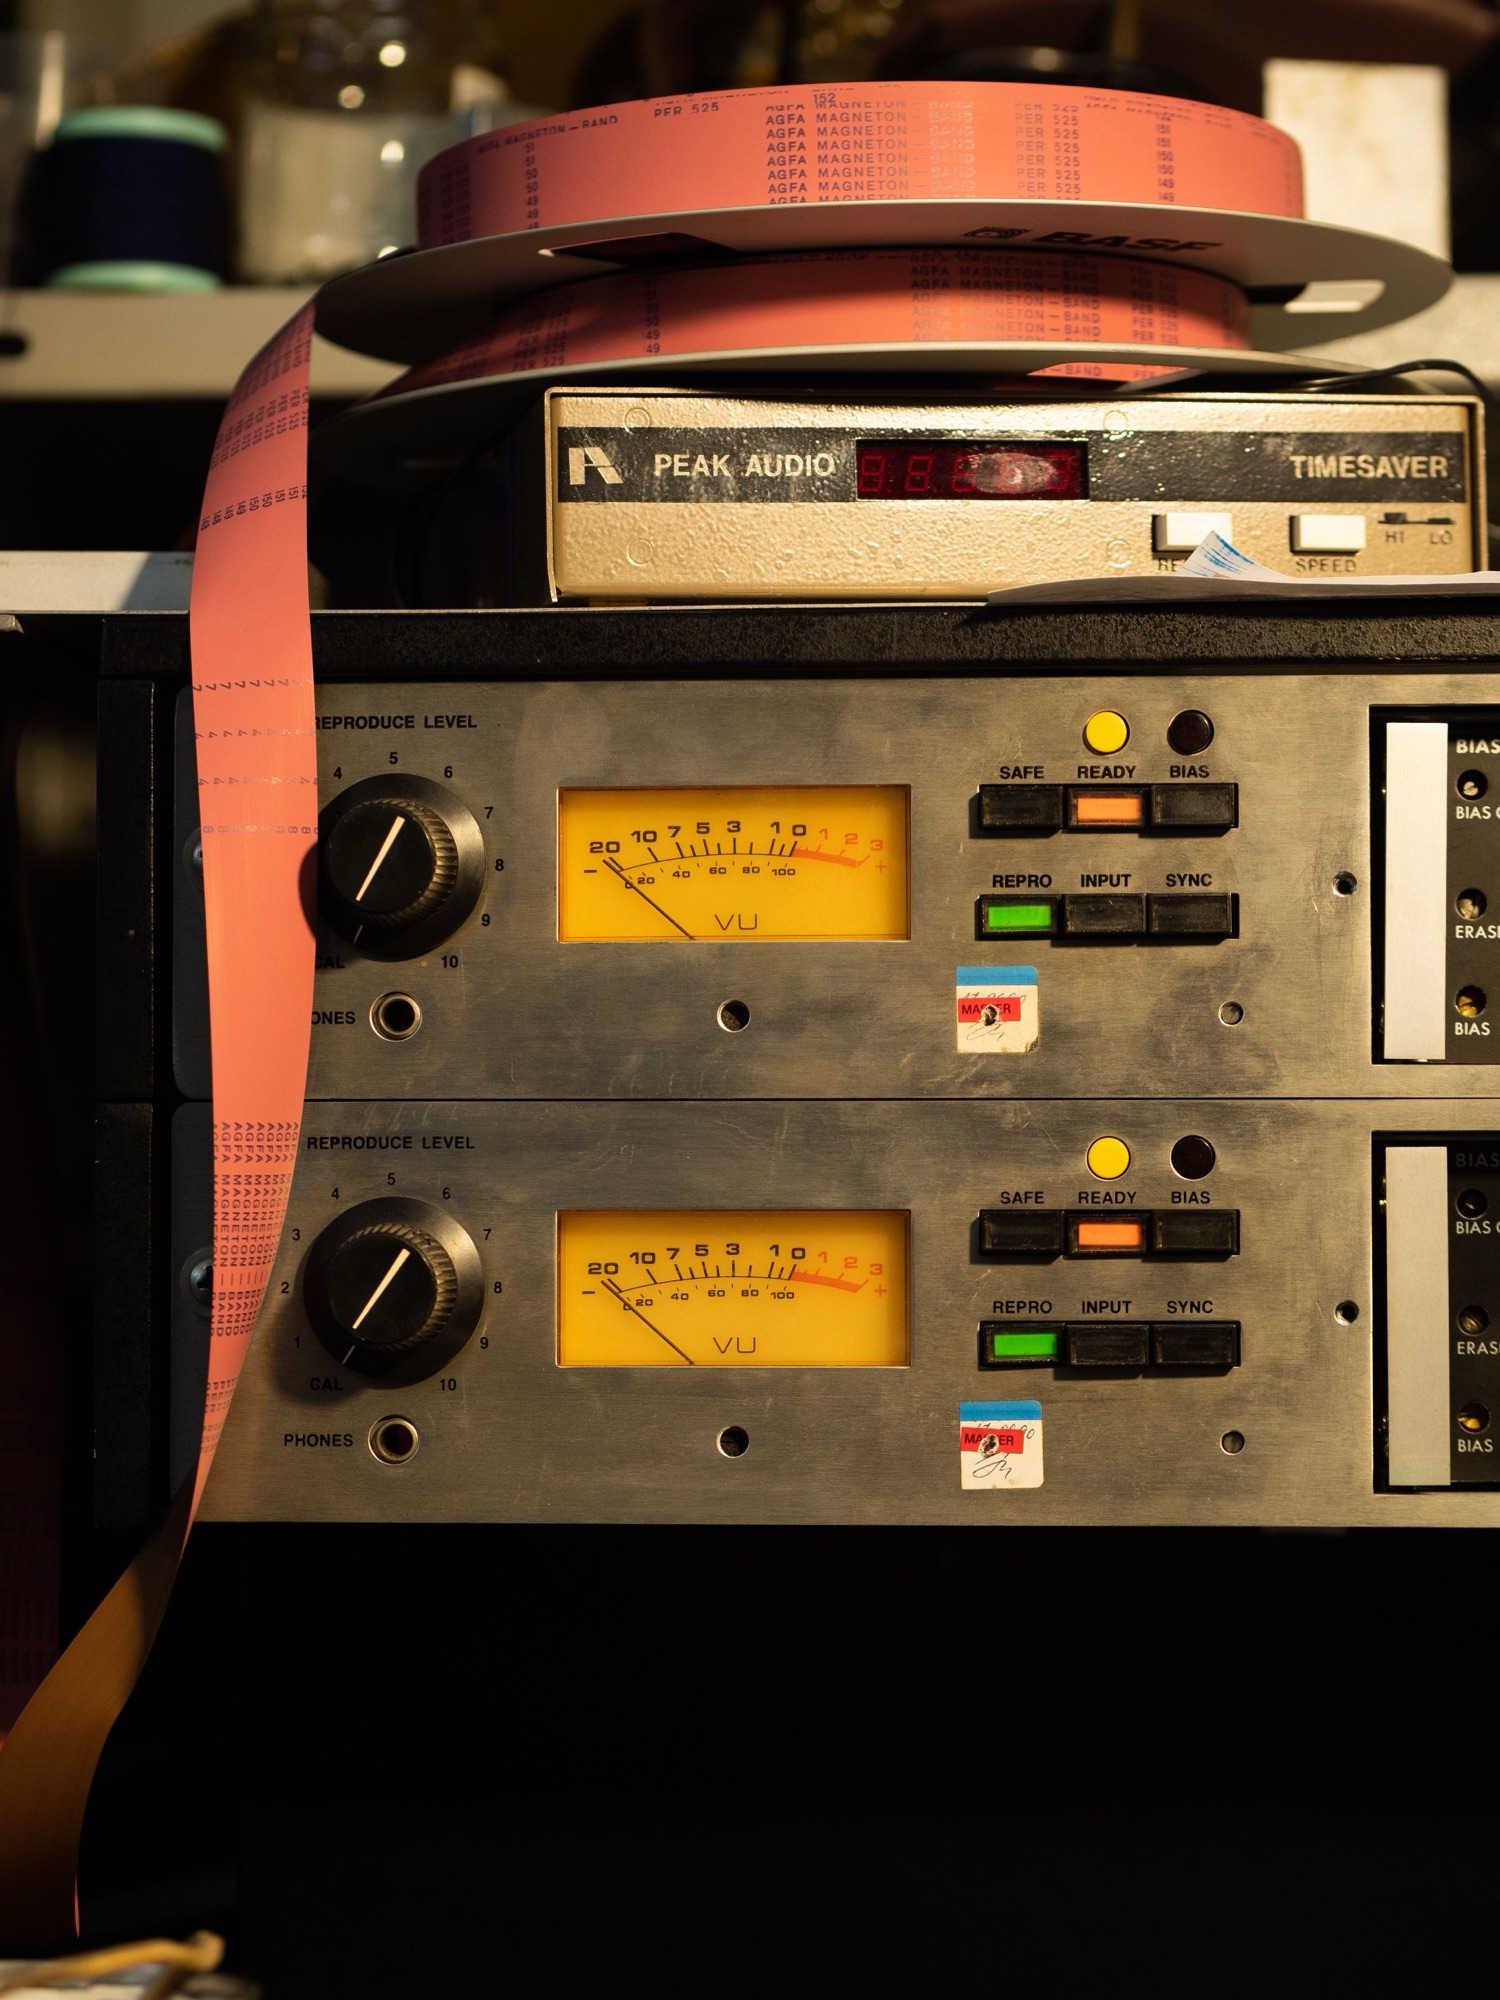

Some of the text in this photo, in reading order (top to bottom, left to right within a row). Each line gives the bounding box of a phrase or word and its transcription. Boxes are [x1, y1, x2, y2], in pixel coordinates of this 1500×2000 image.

[812, 92, 836, 104] 152
[691, 101, 720, 115] 525
[765, 111, 1079, 127] AGFA MAGNETON PER 525
[766, 125, 1080, 140] AGFA MAGNETON PER 525
[766, 138, 1080, 153] AGFA MAGNETON PER 525
[766, 152, 1081, 167] AGFA MAGNETON PER 525
[767, 166, 1081, 181] AGFA MAGNETON PER 525
[767, 180, 1081, 195] AGFA MAGNETON PER 525
[1031, 230, 1224, 252] BASF
[1063, 297, 1100, 311] BAND
[1063, 310, 1100, 324] BAND
[645, 329, 661, 340] 49
[1064, 324, 1100, 337] BAND
[645, 342, 661, 354] 49
[1065, 364, 1102, 377] BAND
[288, 411, 299, 431] 525
[653, 452, 836, 478] PEAK AUDIO
[1289, 454, 1449, 479] TIMESAVER
[261, 491, 273, 508] 150
[275, 489, 286, 503] 151
[288, 485, 299, 501] 151
[236, 499, 246, 516] 149
[249, 495, 260, 512] 150
[223, 504, 234, 521] 149
[1384, 530, 1453, 545] HI LO
[1157, 557, 1182, 572] RE
[1295, 558, 1358, 573] SPEED
[423, 714, 478, 729] LEVEL
[1455, 738, 1500, 754] BIAS
[388, 751, 399, 765] 5
[332, 766, 343, 780] 4
[443, 765, 454, 779] 6
[999, 764, 1210, 780] SAFE READY BIAS
[484, 806, 494, 819] 7
[1455, 805, 1493, 820] BIAS
[588, 820, 884, 854] 20 10 7 5 3 1 0 1 2 3
[494, 858, 505, 872] 8
[636, 876, 656, 885] 20
[672, 870, 691, 879] 40
[708, 866, 728, 876] 60
[742, 865, 761, 875] 80
[771, 867, 797, 877] 100
[991, 873, 1214, 889] REPRO INPUT SYNC
[480, 913, 491, 928] 9
[713, 913, 758, 931] VU
[440, 955, 459, 969] 10
[961, 1002, 1012, 1016] MAER
[311, 1010, 356, 1025] ONES
[1454, 1021, 1491, 1036] BIAS
[306, 1135, 476, 1151] REPRODUCE LEVEL
[386, 1173, 396, 1186] 5
[330, 1187, 341, 1201] 4
[442, 1187, 451, 1200] 6
[1000, 1190, 1211, 1205] SAFE READY BIAS
[216, 1121, 232, 1337] AGFA MAGNETON BAND
[225, 1121, 244, 1337] AGFA MAGNETON BAND
[291, 1228, 301, 1242] 3
[483, 1228, 493, 1241] 7
[1455, 1220, 1492, 1235] BIAS
[587, 1242, 884, 1276] 20 10 7 5 3 1 0 1 2 3
[280, 1281, 290, 1295] 2
[493, 1281, 503, 1295] 8
[635, 1298, 654, 1307] 20
[670, 1291, 690, 1301] 40
[707, 1289, 726, 1298] 60
[740, 1288, 760, 1298] 80
[770, 1291, 795, 1300] 100
[992, 1299, 1214, 1315] REPRO INPUT SYNC
[293, 1336, 300, 1349] 1
[479, 1337, 490, 1350] 9
[712, 1336, 757, 1354] VU
[1456, 1341, 1500, 1355] ERAS
[309, 1377, 344, 1392] CAL
[439, 1378, 458, 1392] 10
[283, 1433, 354, 1448] PHONES
[964, 1433, 1015, 1447] MAER
[1457, 1438, 1494, 1453] BIAS
